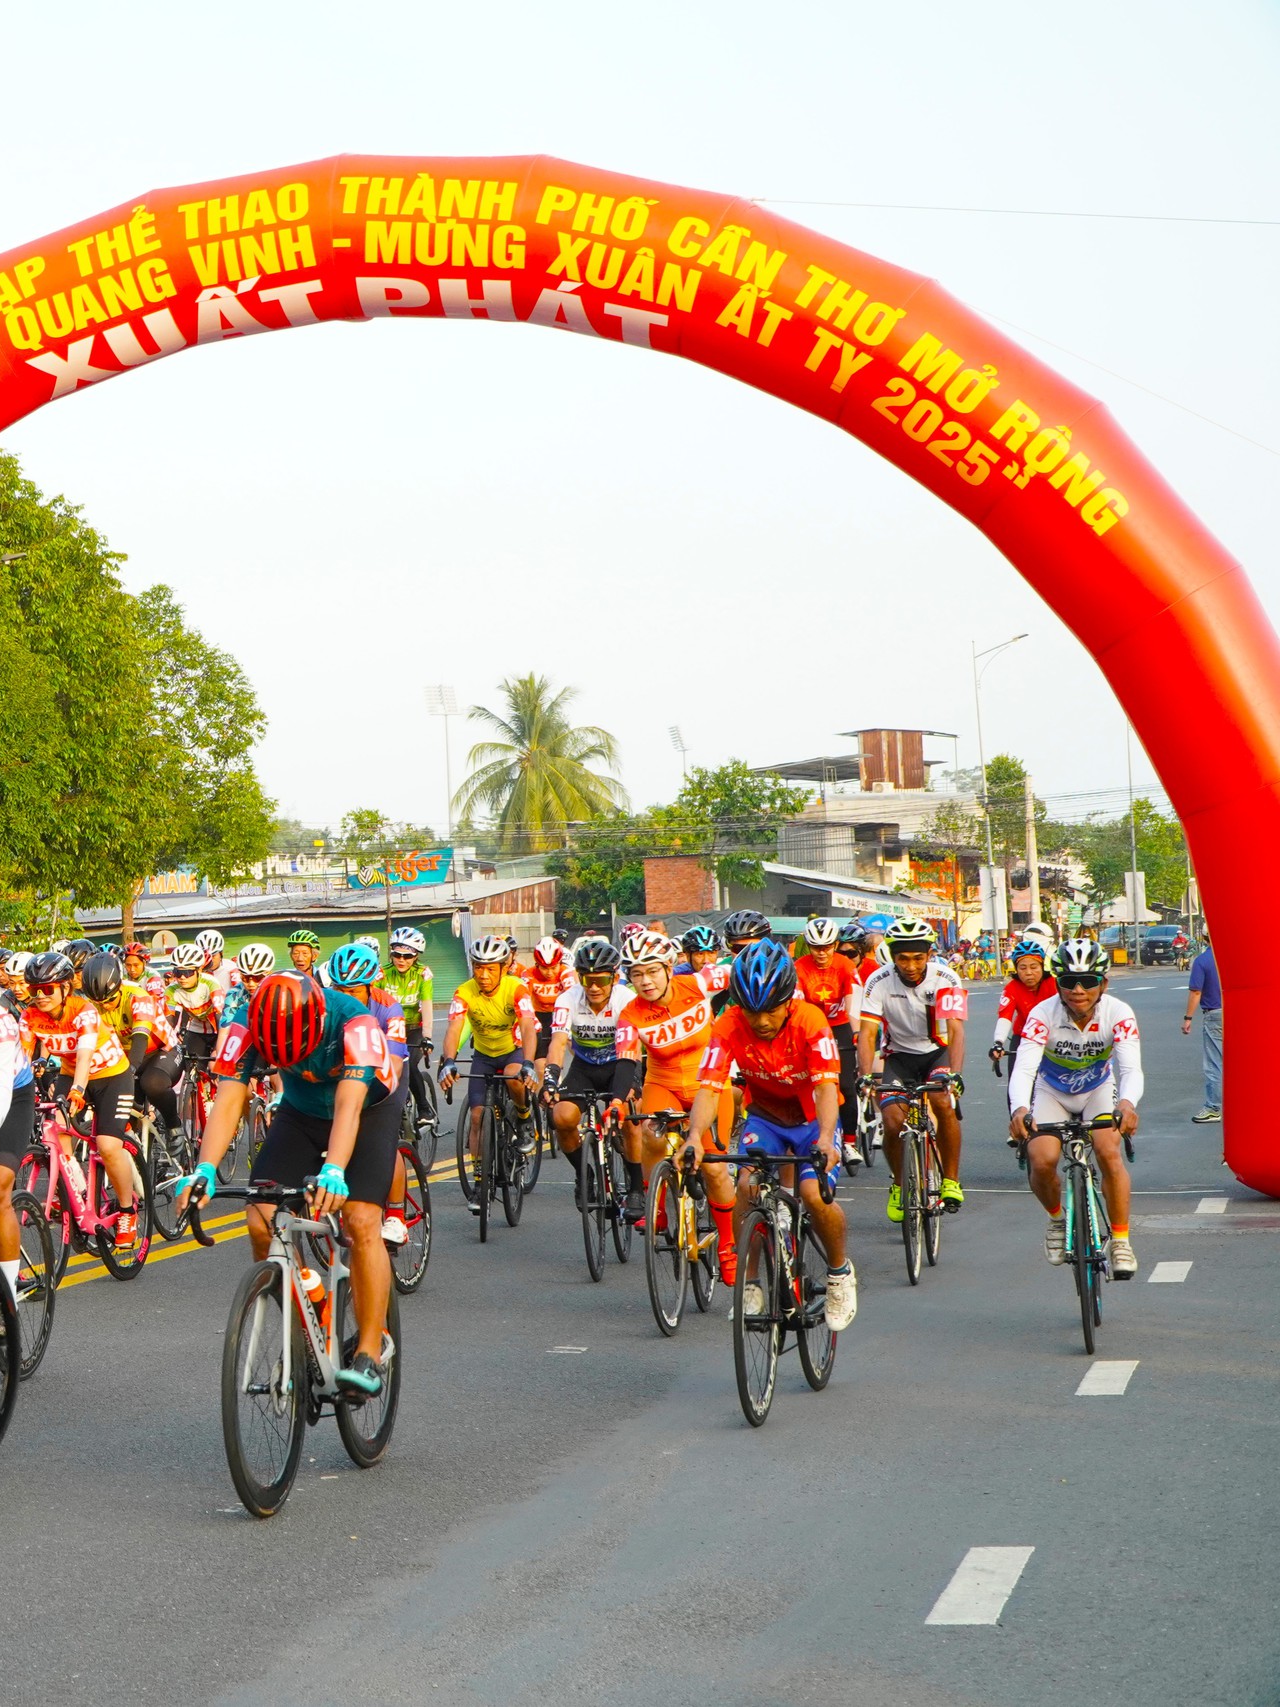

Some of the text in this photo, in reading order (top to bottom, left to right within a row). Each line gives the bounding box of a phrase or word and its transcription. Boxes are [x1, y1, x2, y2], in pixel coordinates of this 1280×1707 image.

[5, 258, 177, 352] QUANG
[188, 224, 317, 287] VINH
[365, 217, 526, 269] MỪNG
[546, 232, 703, 313] XUÂN
[715, 282, 794, 348] ẤT
[25, 275, 670, 400] XUẤT PHÁT
[68, 203, 162, 277] THỂ
[178, 183, 309, 240] THAO
[339, 173, 518, 221] THÀNH
[535, 185, 660, 241] PHỐ
[667, 216, 787, 291] CẦN
[794, 264, 907, 347] THƠ
[898, 331, 1001, 414] MỞ
[988, 398, 1130, 537] RỘNG
[132, 1001, 155, 1016] 245
[942, 994, 964, 1012] 02
[72, 1009, 97, 1029] 255
[386, 1019, 407, 1038] 26
[645, 1004, 706, 1045] TÂY ĐÔ
[1114, 1018, 1139, 1042] 42
[66, 1036, 78, 1051] Đ
[353, 1025, 383, 1055] 19
[1023, 1019, 1050, 1045] 42
[819, 1036, 839, 1060] 01
[1056, 1040, 1105, 1051] CÔNG DANH
[343, 1069, 365, 1079] PAS
[58, 1153, 87, 1213] DOGMA
